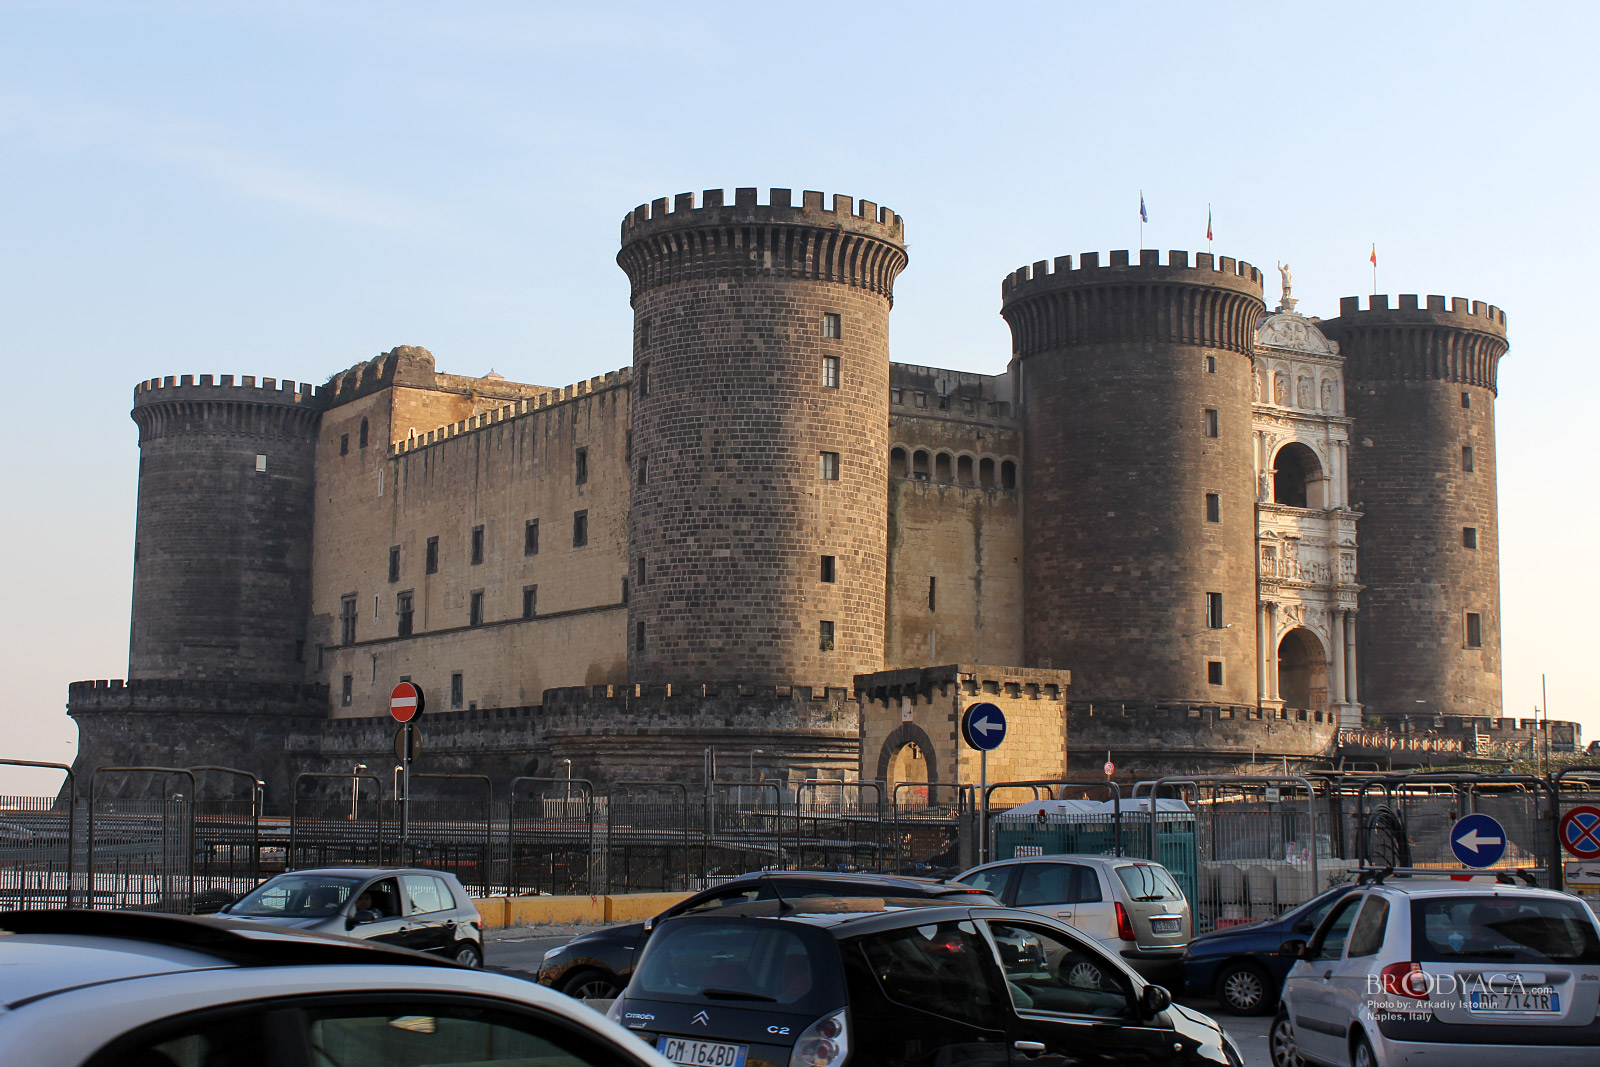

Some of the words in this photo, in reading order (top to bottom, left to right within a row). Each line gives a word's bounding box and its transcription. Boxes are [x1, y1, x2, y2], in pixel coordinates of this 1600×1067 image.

[1504, 993, 1550, 1010] 714TR
[767, 1025, 790, 1035] C2
[666, 1040, 686, 1061] CM
[690, 1043, 735, 1067] 164BD
